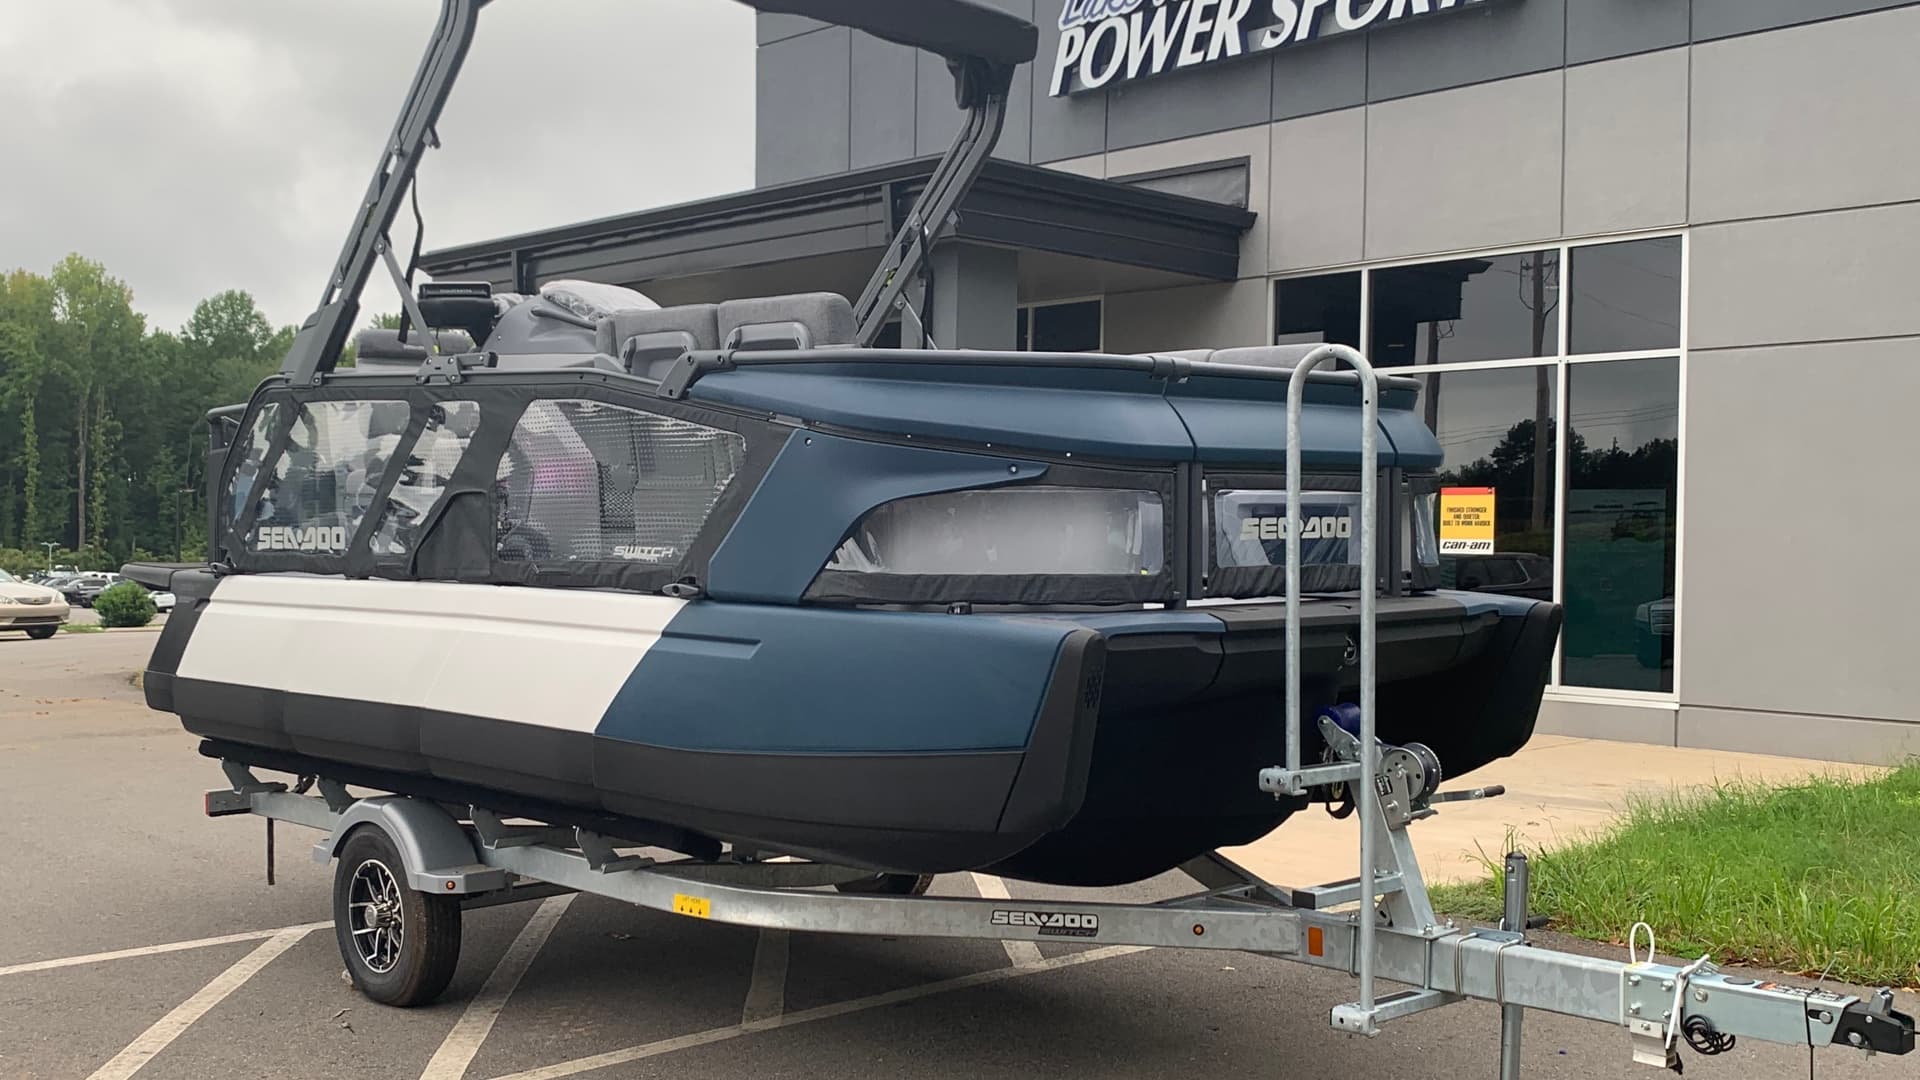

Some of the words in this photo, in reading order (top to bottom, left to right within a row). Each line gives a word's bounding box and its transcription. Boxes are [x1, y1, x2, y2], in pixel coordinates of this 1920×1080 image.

[1049, 0, 1243, 97] POWER
[613, 545, 674, 558] SWITCH
[1442, 541, 1491, 550] can-am
